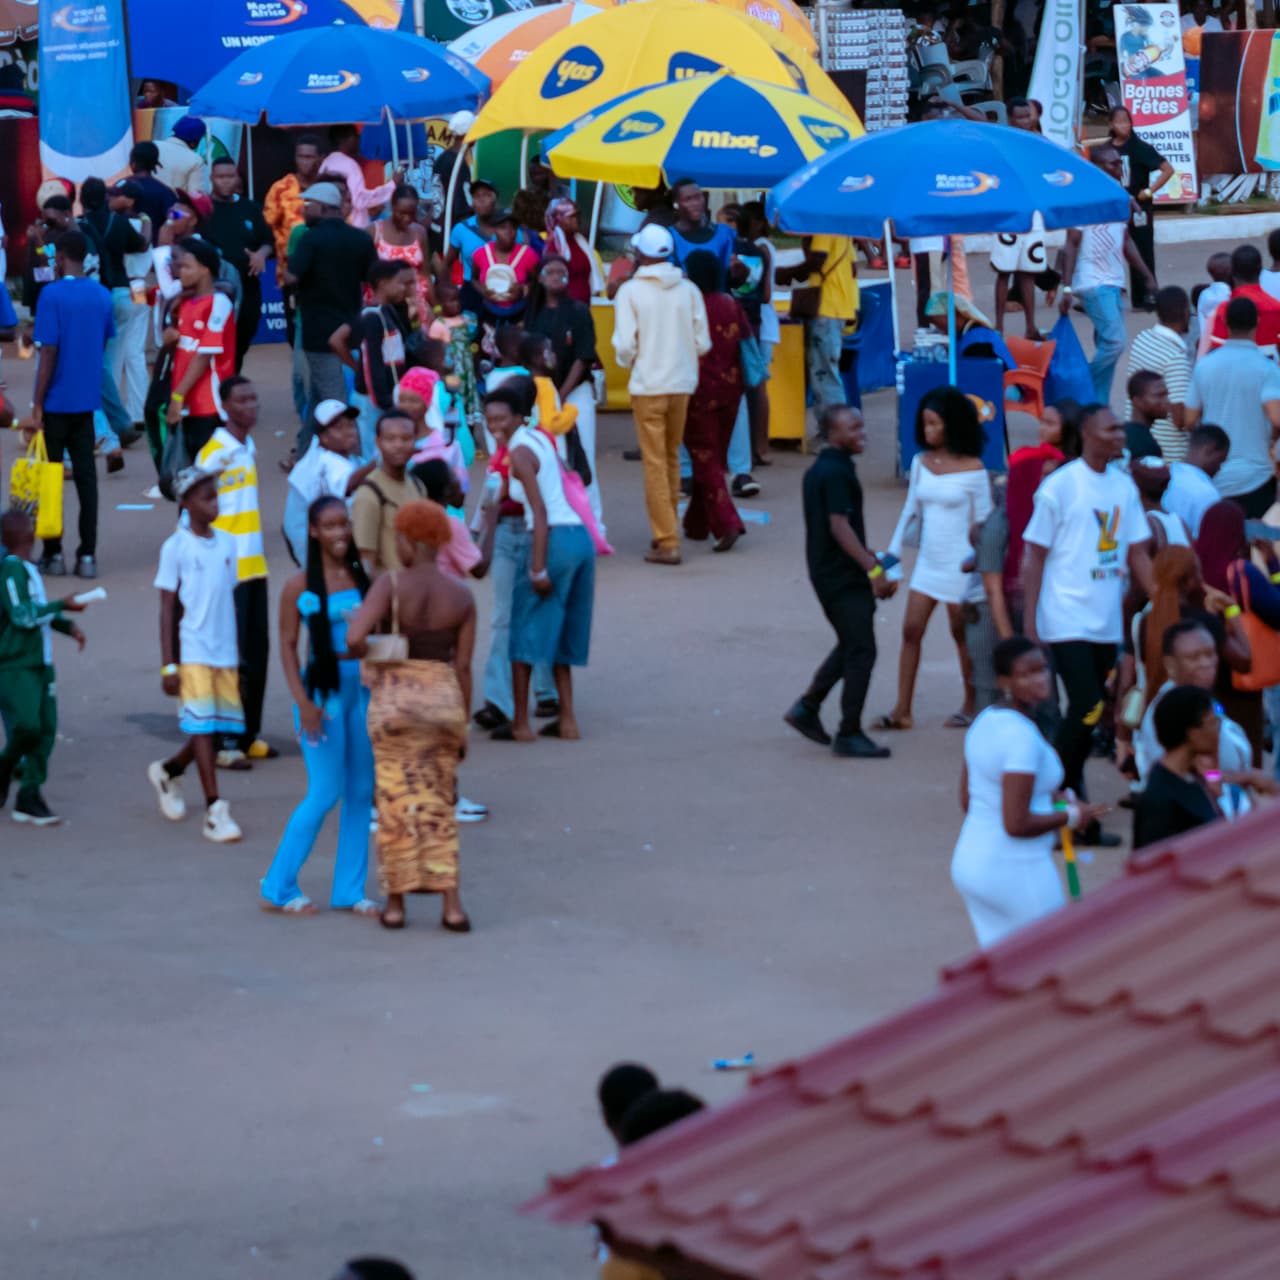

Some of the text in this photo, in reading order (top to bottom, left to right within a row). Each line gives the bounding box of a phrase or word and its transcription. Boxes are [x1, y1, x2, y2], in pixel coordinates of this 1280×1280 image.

[246, 1, 281, 11] Moov
[250, 8, 286, 19] Africa
[222, 36, 240, 48] UN
[1125, 83, 1184, 100] Bonnes
[1131, 97, 1179, 116] Fêtes
